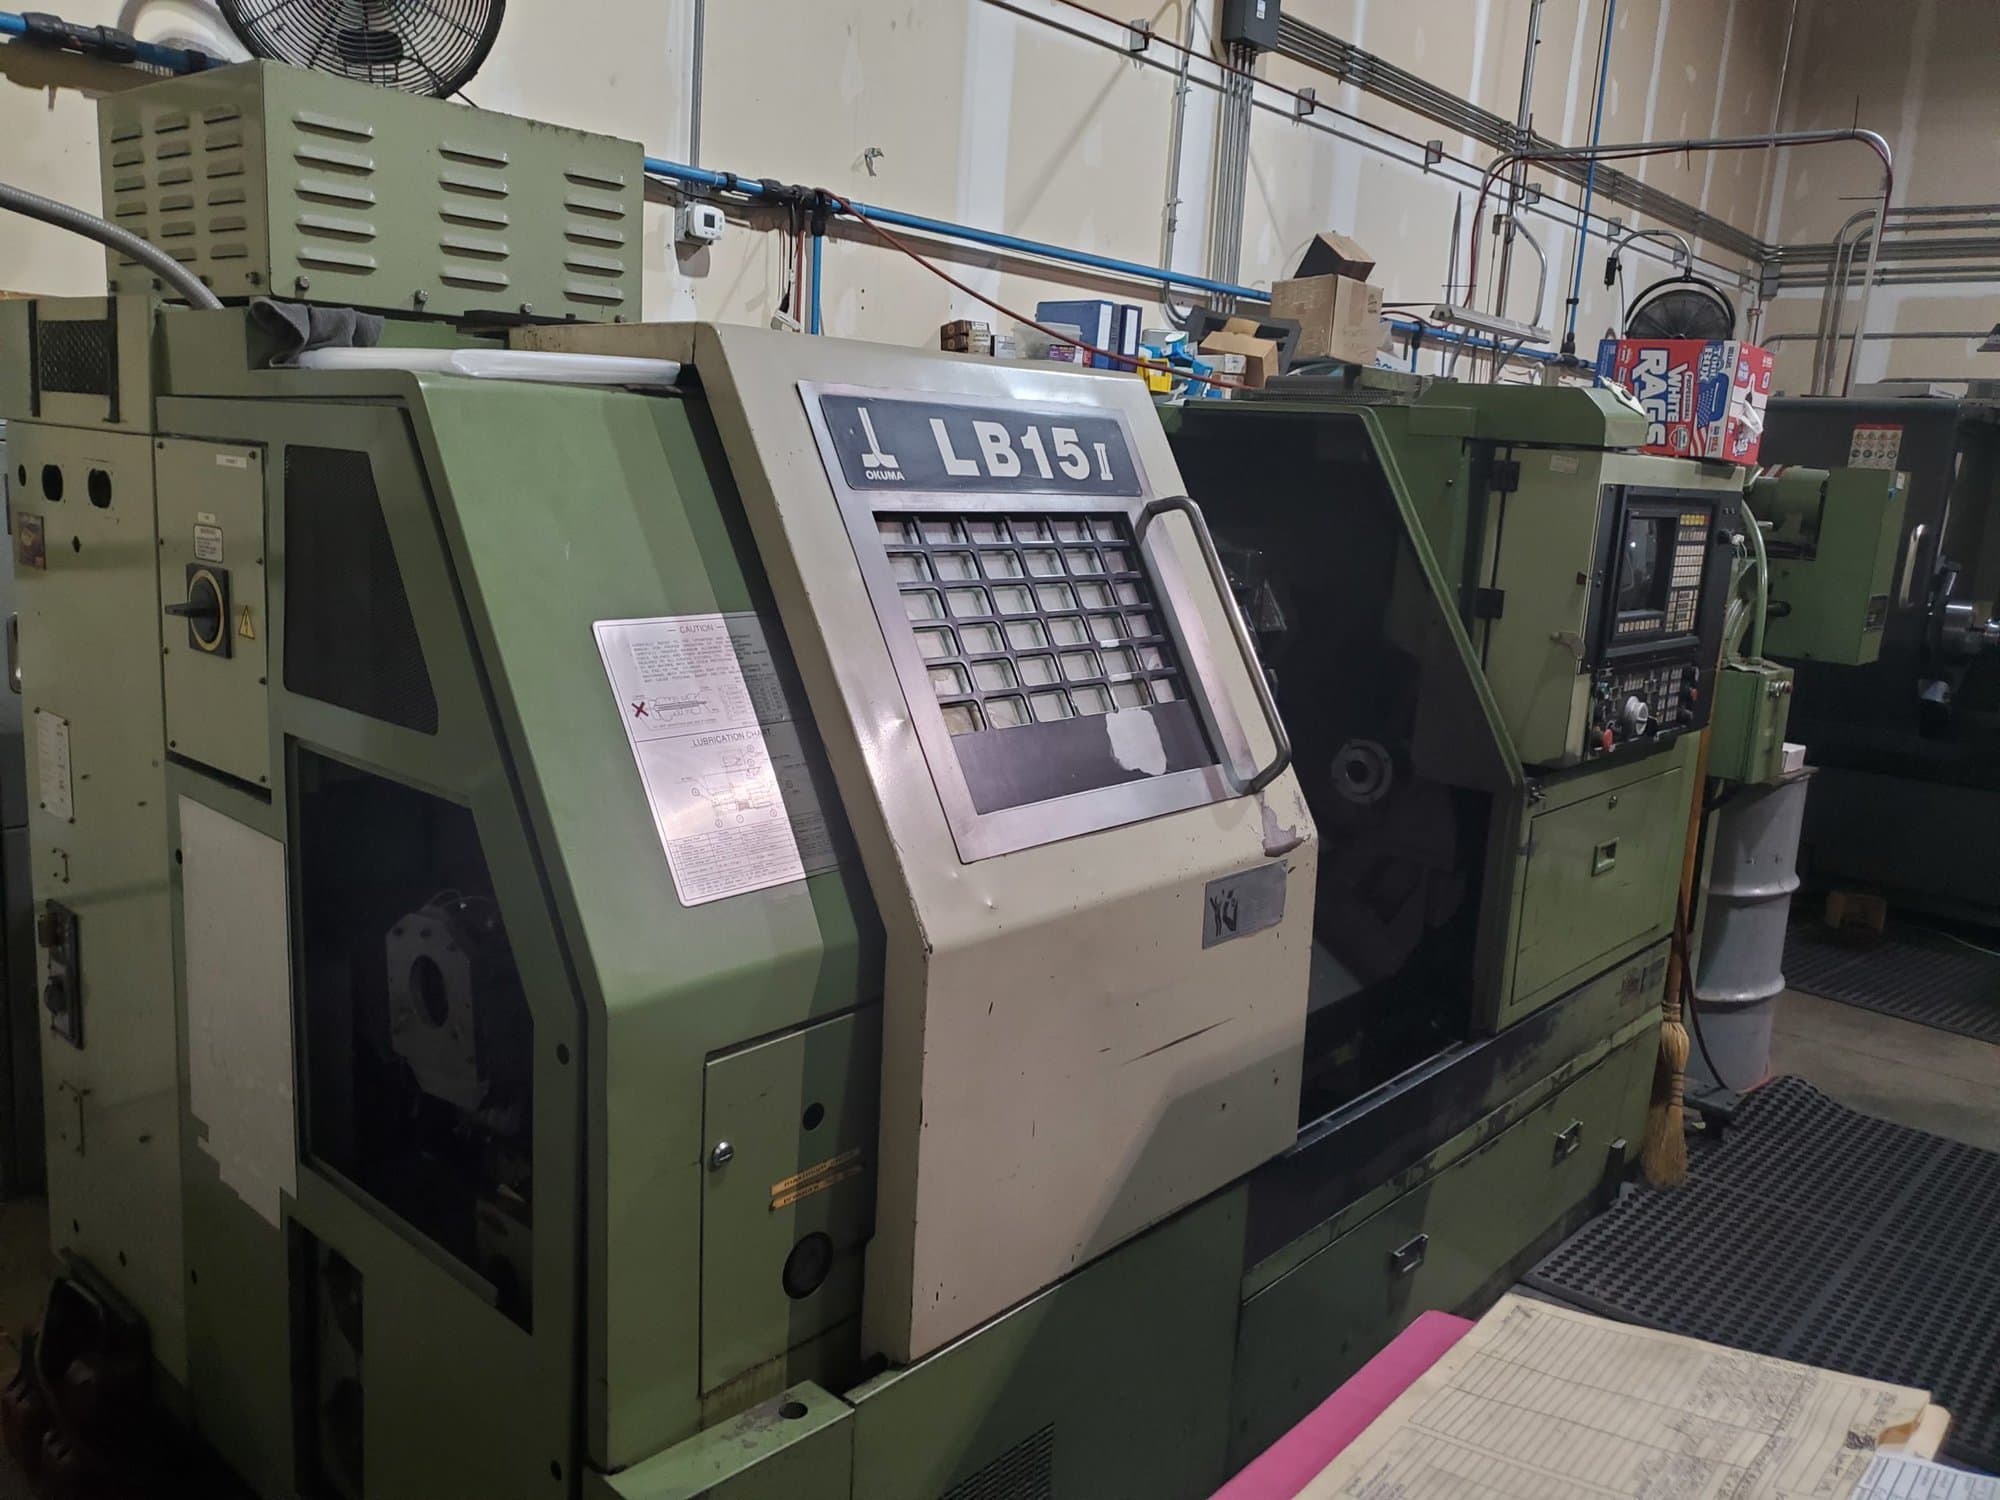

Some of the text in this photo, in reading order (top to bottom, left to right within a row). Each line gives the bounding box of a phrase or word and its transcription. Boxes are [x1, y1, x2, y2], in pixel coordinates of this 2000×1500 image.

[1700, 347, 1713, 381] BOX
[1710, 347, 1721, 378] TOOL
[1632, 350, 1668, 445] RAGS
[1668, 363, 1688, 422] WHITE
[865, 470, 906, 480] OKUMA
[679, 624, 714, 634] CAUTION
[693, 728, 770, 747] LUBRICATION CHART
